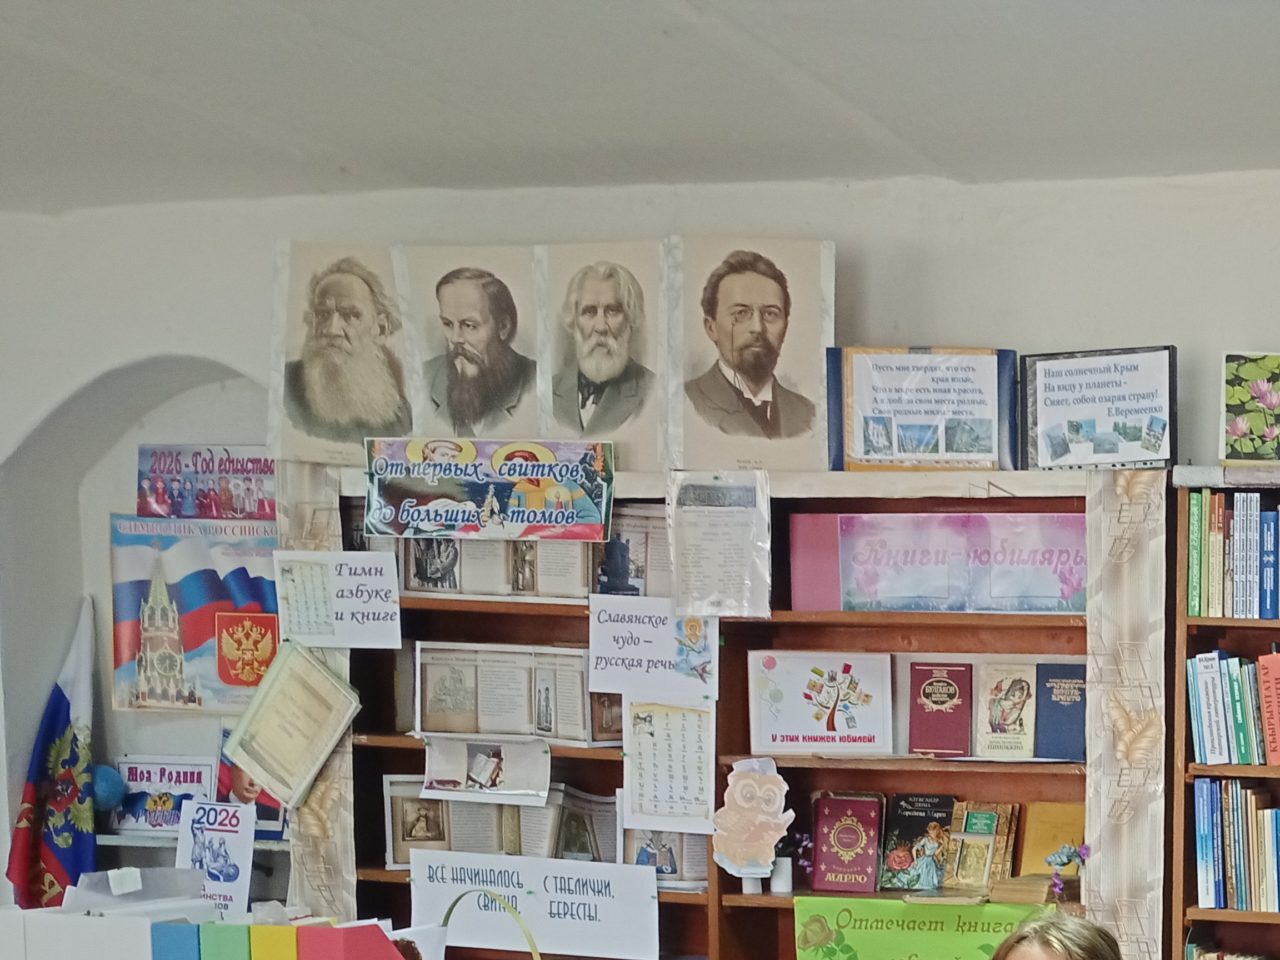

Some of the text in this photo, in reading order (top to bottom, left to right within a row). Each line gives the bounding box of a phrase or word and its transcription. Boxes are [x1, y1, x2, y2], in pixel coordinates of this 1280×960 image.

[1044, 363, 1139, 378] Наш солнечный Крым
[1044, 380, 1122, 393] На виду планеты
[1073, 395, 1096, 405] собой
[1128, 389, 1158, 401] страну!
[149, 451, 182, 475] 2026
[192, 447, 214, 475] Год
[372, 456, 585, 485] От первых свитков,
[370, 499, 578, 527] до больших томов
[335, 563, 384, 576] Гимн
[336, 584, 392, 604] азбуке
[335, 611, 397, 625] и книге
[597, 609, 668, 628] Славянское
[613, 630, 640, 650] чудо
[594, 655, 675, 673] русская речь
[780, 734, 799, 744] этих
[801, 733, 837, 745] книжек
[839, 733, 876, 745] юбилей!
[195, 806, 240, 828] 2026
[427, 864, 615, 899] ВСЁ НАЧИНАЛОСЬ ТАБЛИЧКИ,
[825, 873, 868, 883] МАРГО
[834, 907, 1015, 935] Отмечает книга
